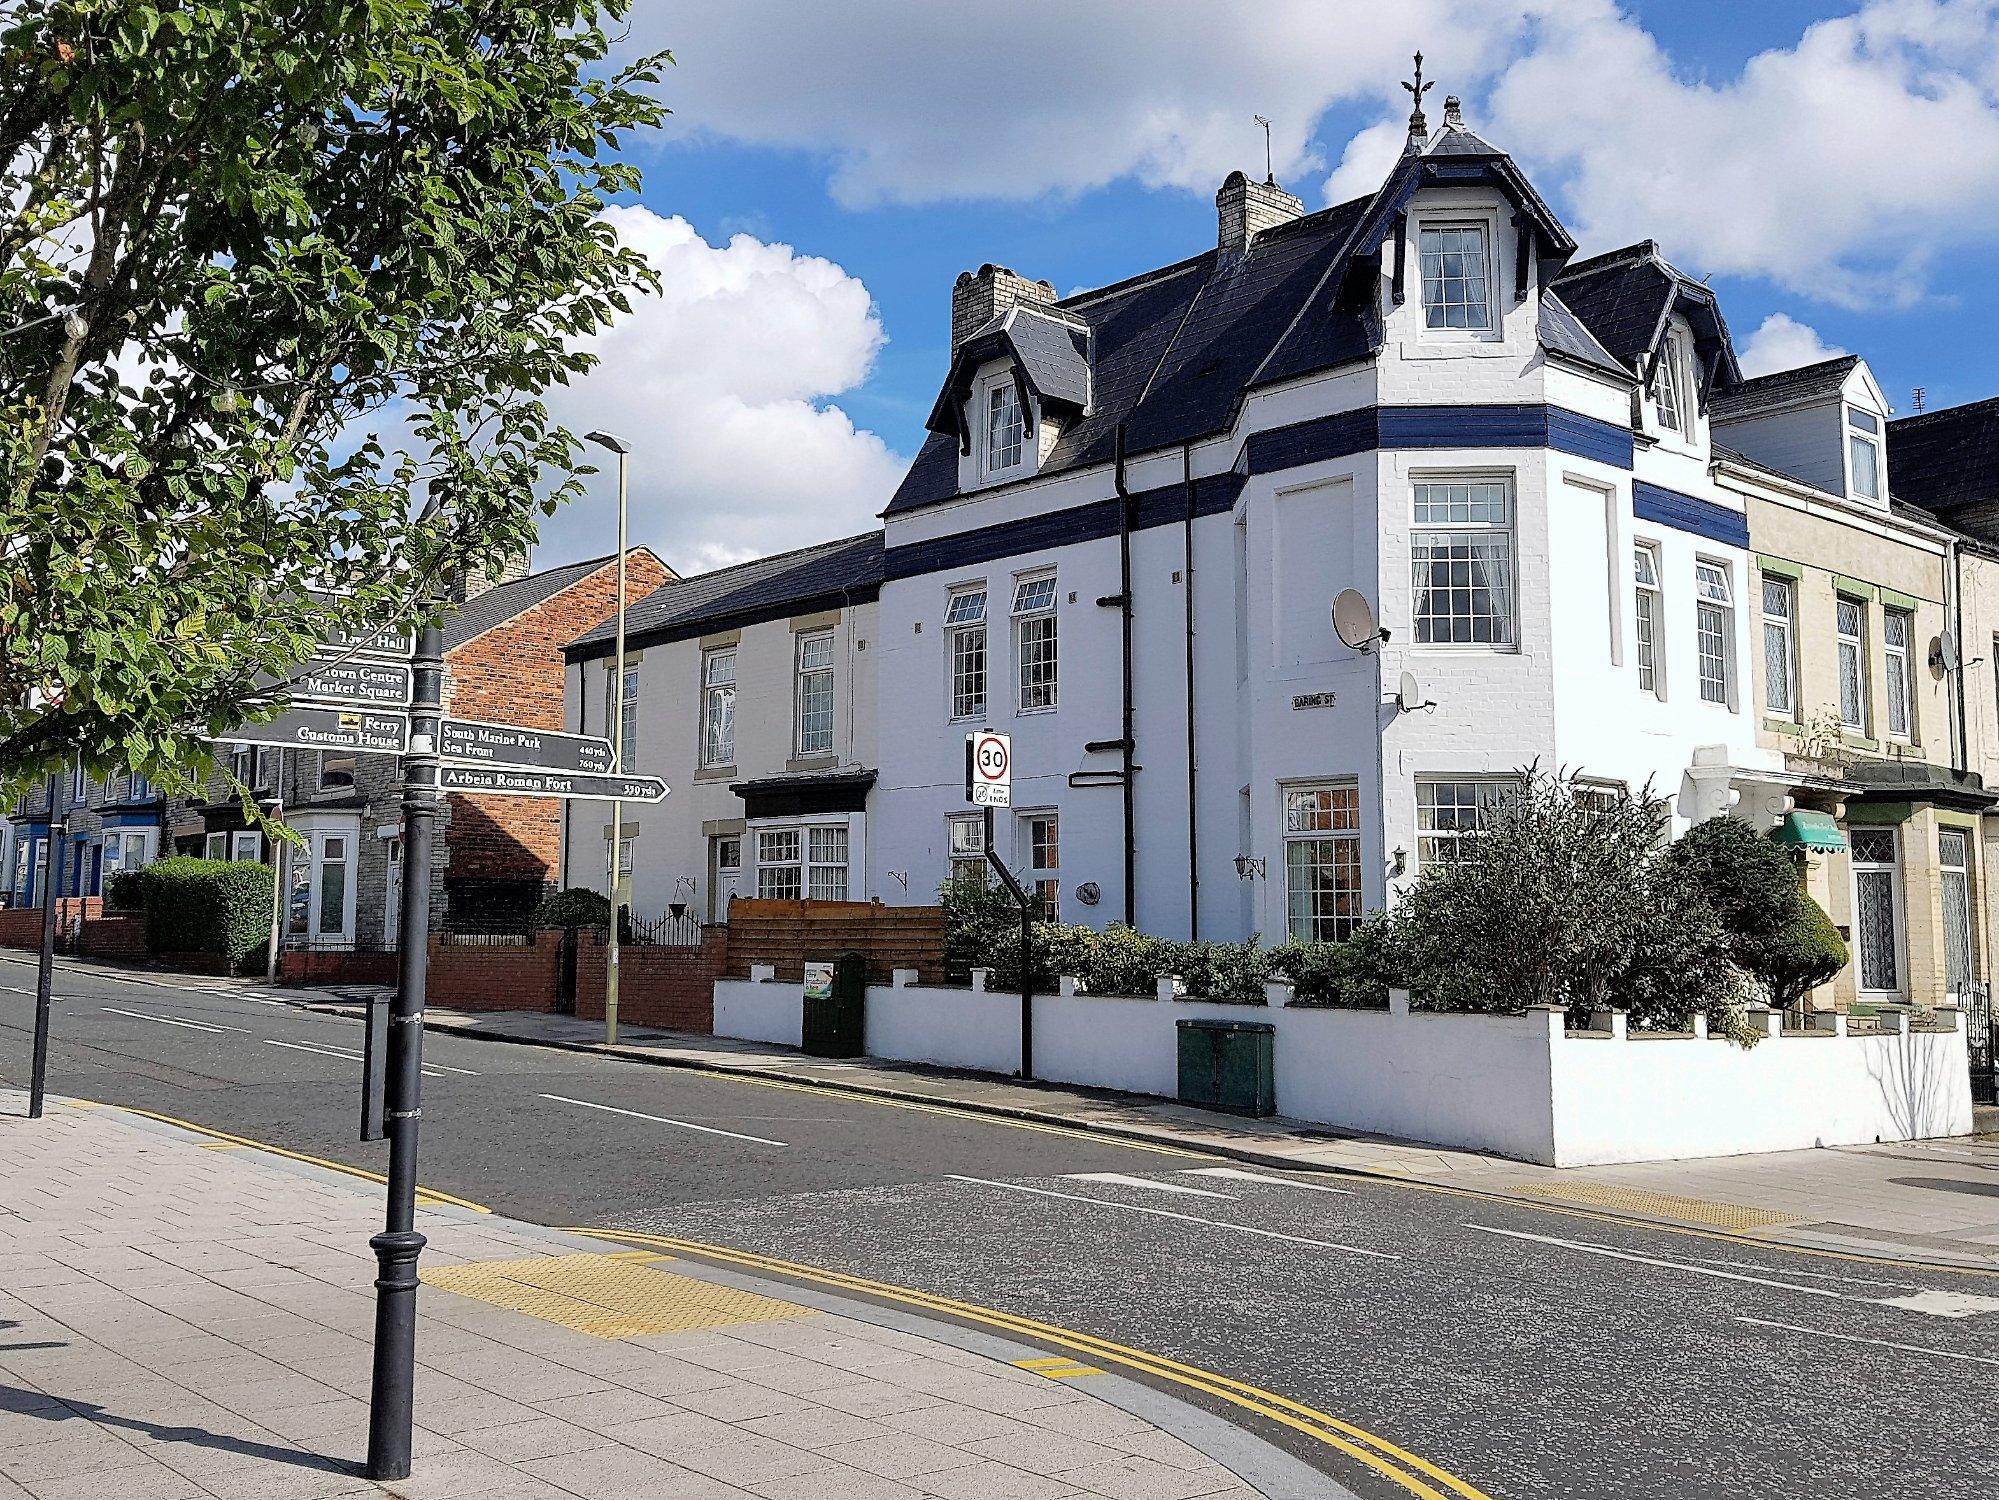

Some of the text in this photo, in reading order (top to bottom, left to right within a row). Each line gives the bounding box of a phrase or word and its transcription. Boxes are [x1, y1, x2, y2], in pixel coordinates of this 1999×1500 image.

[376, 635, 405, 650] Hall
[359, 668, 404, 684] Centre
[307, 677, 403, 700] Market Square
[1294, 696, 1321, 707] BARING
[365, 716, 400, 735] Ferry
[297, 726, 400, 748] Customs House
[443, 725, 475, 741] South
[478, 729, 516, 745] Marine
[517, 734, 541, 750] Park
[442, 740, 463, 754] Sea
[465, 742, 494, 758] Front
[982, 750, 1003, 767] 30
[446, 770, 493, 786] Arbeia
[495, 773, 542, 789] Roman
[545, 776, 572, 791] Fort
